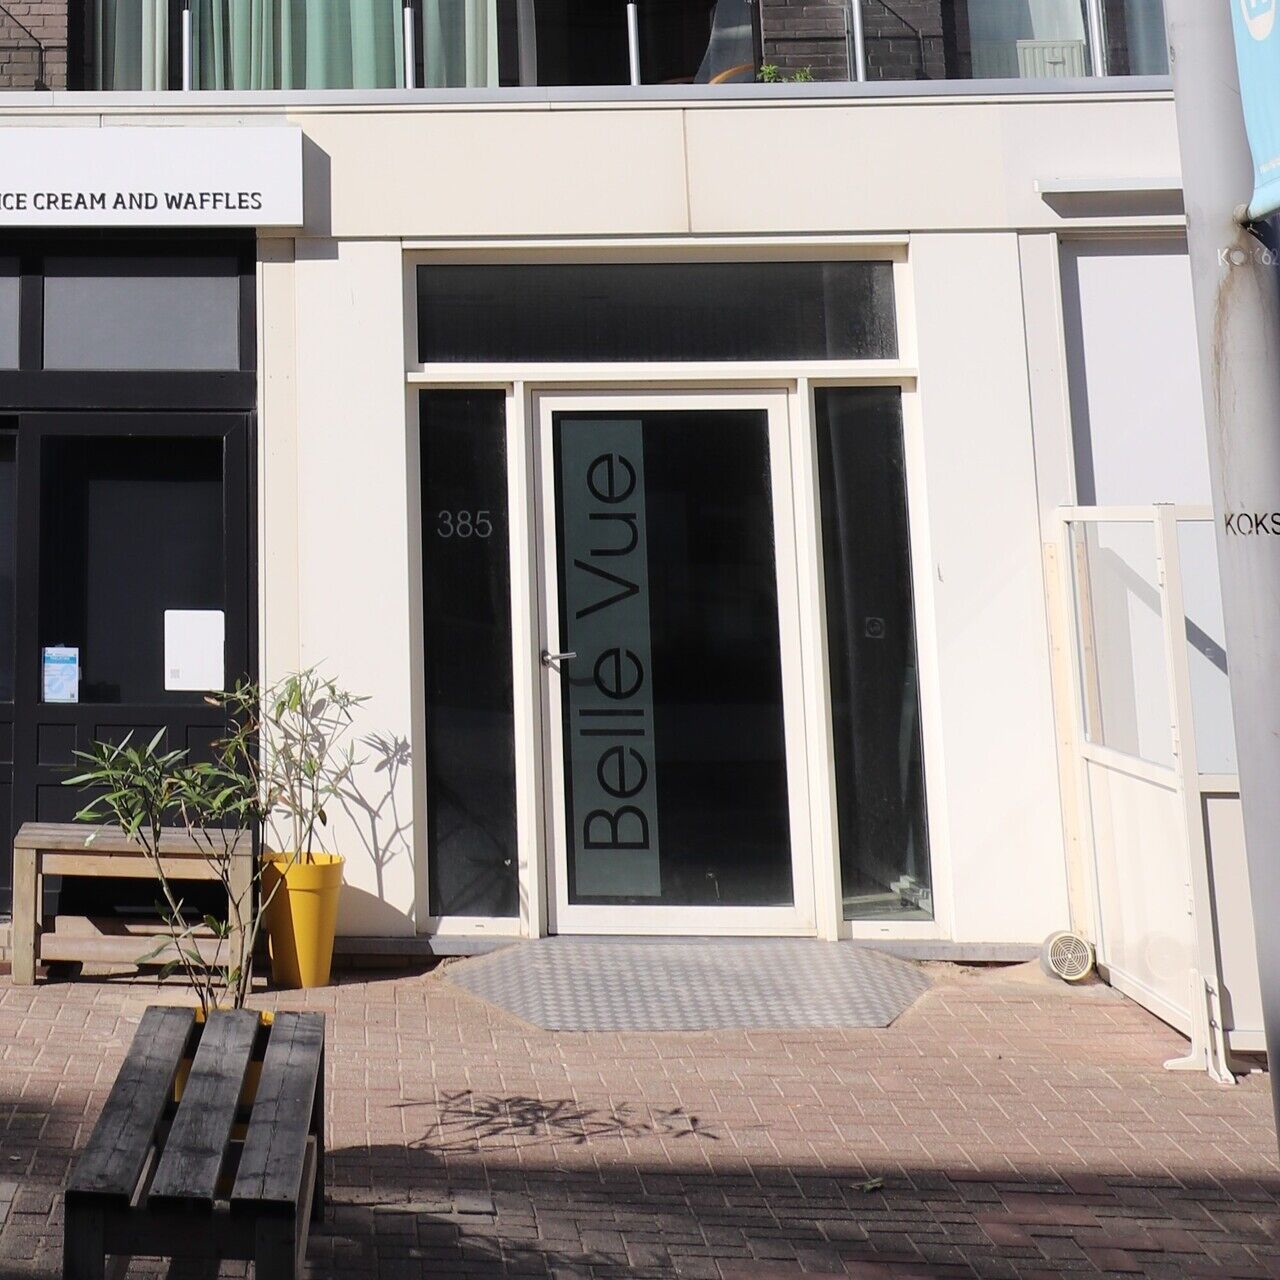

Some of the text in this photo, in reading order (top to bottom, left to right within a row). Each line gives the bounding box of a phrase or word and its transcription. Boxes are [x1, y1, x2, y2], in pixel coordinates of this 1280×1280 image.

[32, 192, 107, 211] CREAM
[112, 192, 159, 211] AND
[163, 192, 263, 211] WAFFLES
[436, 509, 494, 539] 385
[573, 452, 650, 851] Belle Vue
